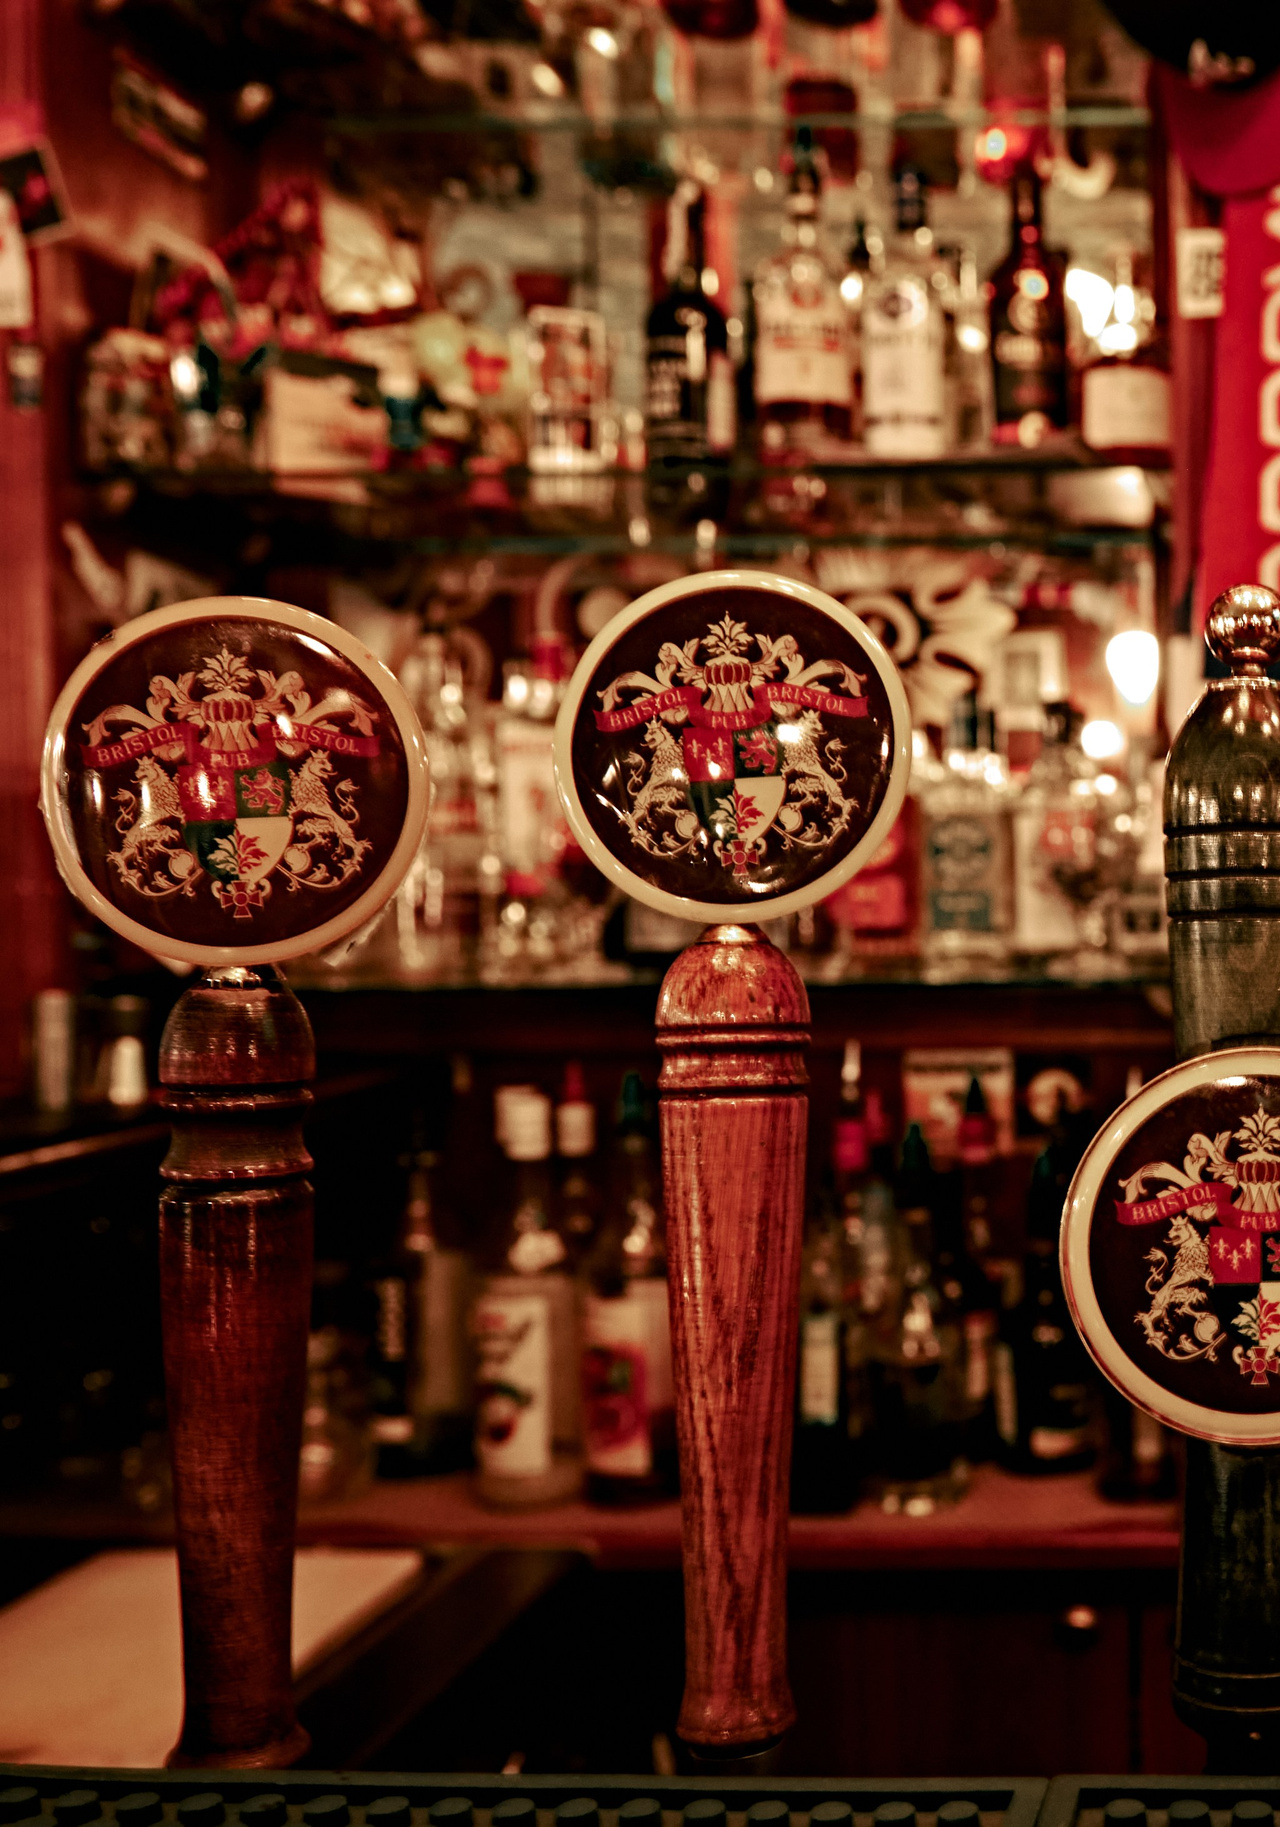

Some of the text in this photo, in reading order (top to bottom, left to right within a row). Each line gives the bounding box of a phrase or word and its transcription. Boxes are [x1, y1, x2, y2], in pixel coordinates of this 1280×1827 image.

[609, 686, 849, 728] BRISTOL PUB BRISTOL
[96, 725, 360, 767] BRISTOL PUB BRISTOL
[1132, 1187, 1217, 1219] BRISTOL
[1240, 1216, 1278, 1230] PUB
